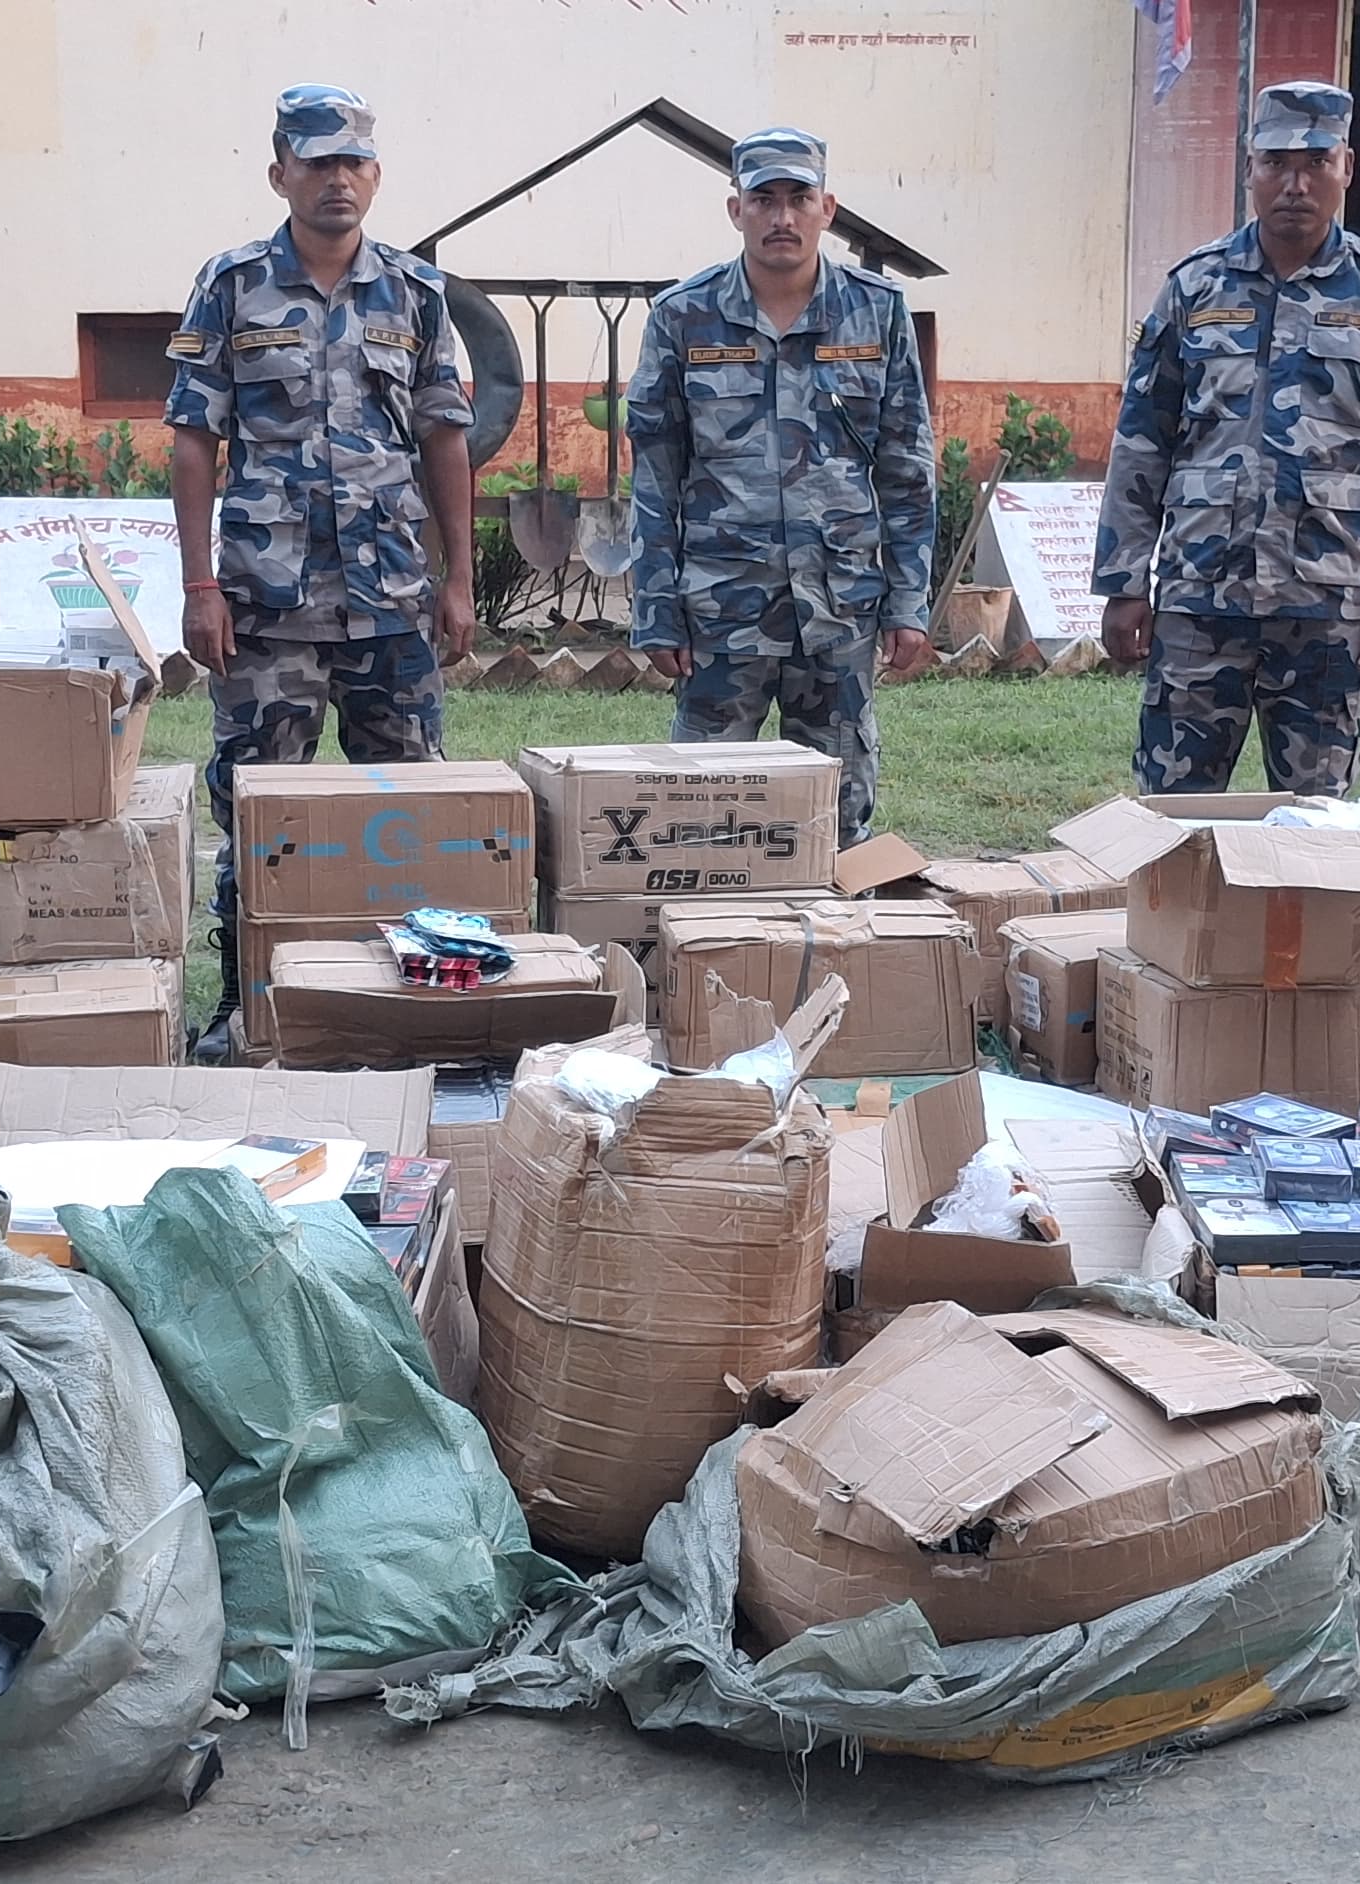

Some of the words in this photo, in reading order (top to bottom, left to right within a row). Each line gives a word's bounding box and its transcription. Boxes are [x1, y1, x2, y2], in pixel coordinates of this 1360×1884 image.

[635, 774, 677, 784] GLASS
[685, 774, 736, 784] CURVED
[743, 774, 768, 784] BIG
[599, 806, 652, 864] X
[650, 810, 799, 860] Super
[646, 869, 700, 890] ESD
